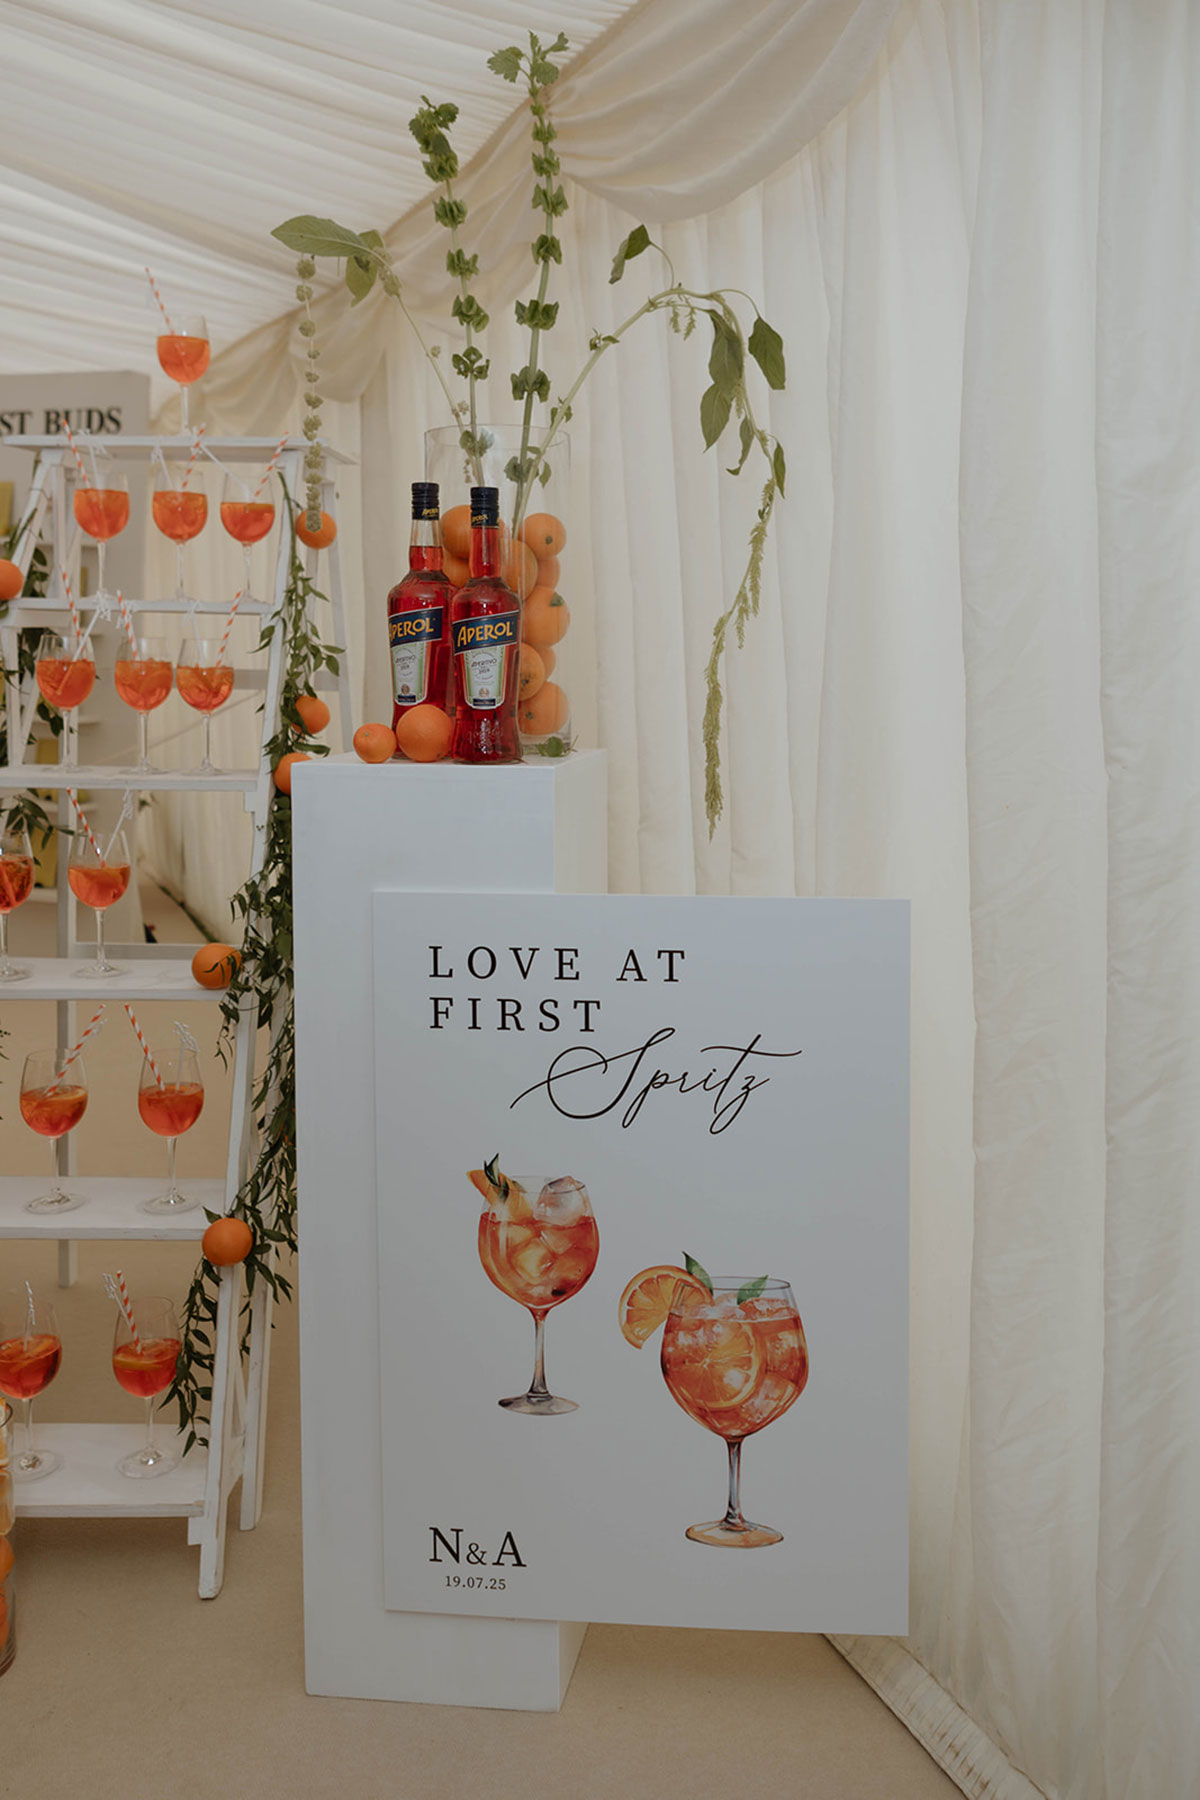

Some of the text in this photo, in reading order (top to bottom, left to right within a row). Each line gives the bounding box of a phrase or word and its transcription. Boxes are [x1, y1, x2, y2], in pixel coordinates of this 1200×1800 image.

[44, 406, 122, 435] BUDS
[457, 621, 513, 647] APEROL
[429, 945, 686, 982] LOVE AT
[429, 997, 601, 1032] FIRST
[510, 1027, 802, 1134] Spritz
[429, 1526, 527, 1567] N&A
[445, 1575, 506, 1590] 19.07.25
